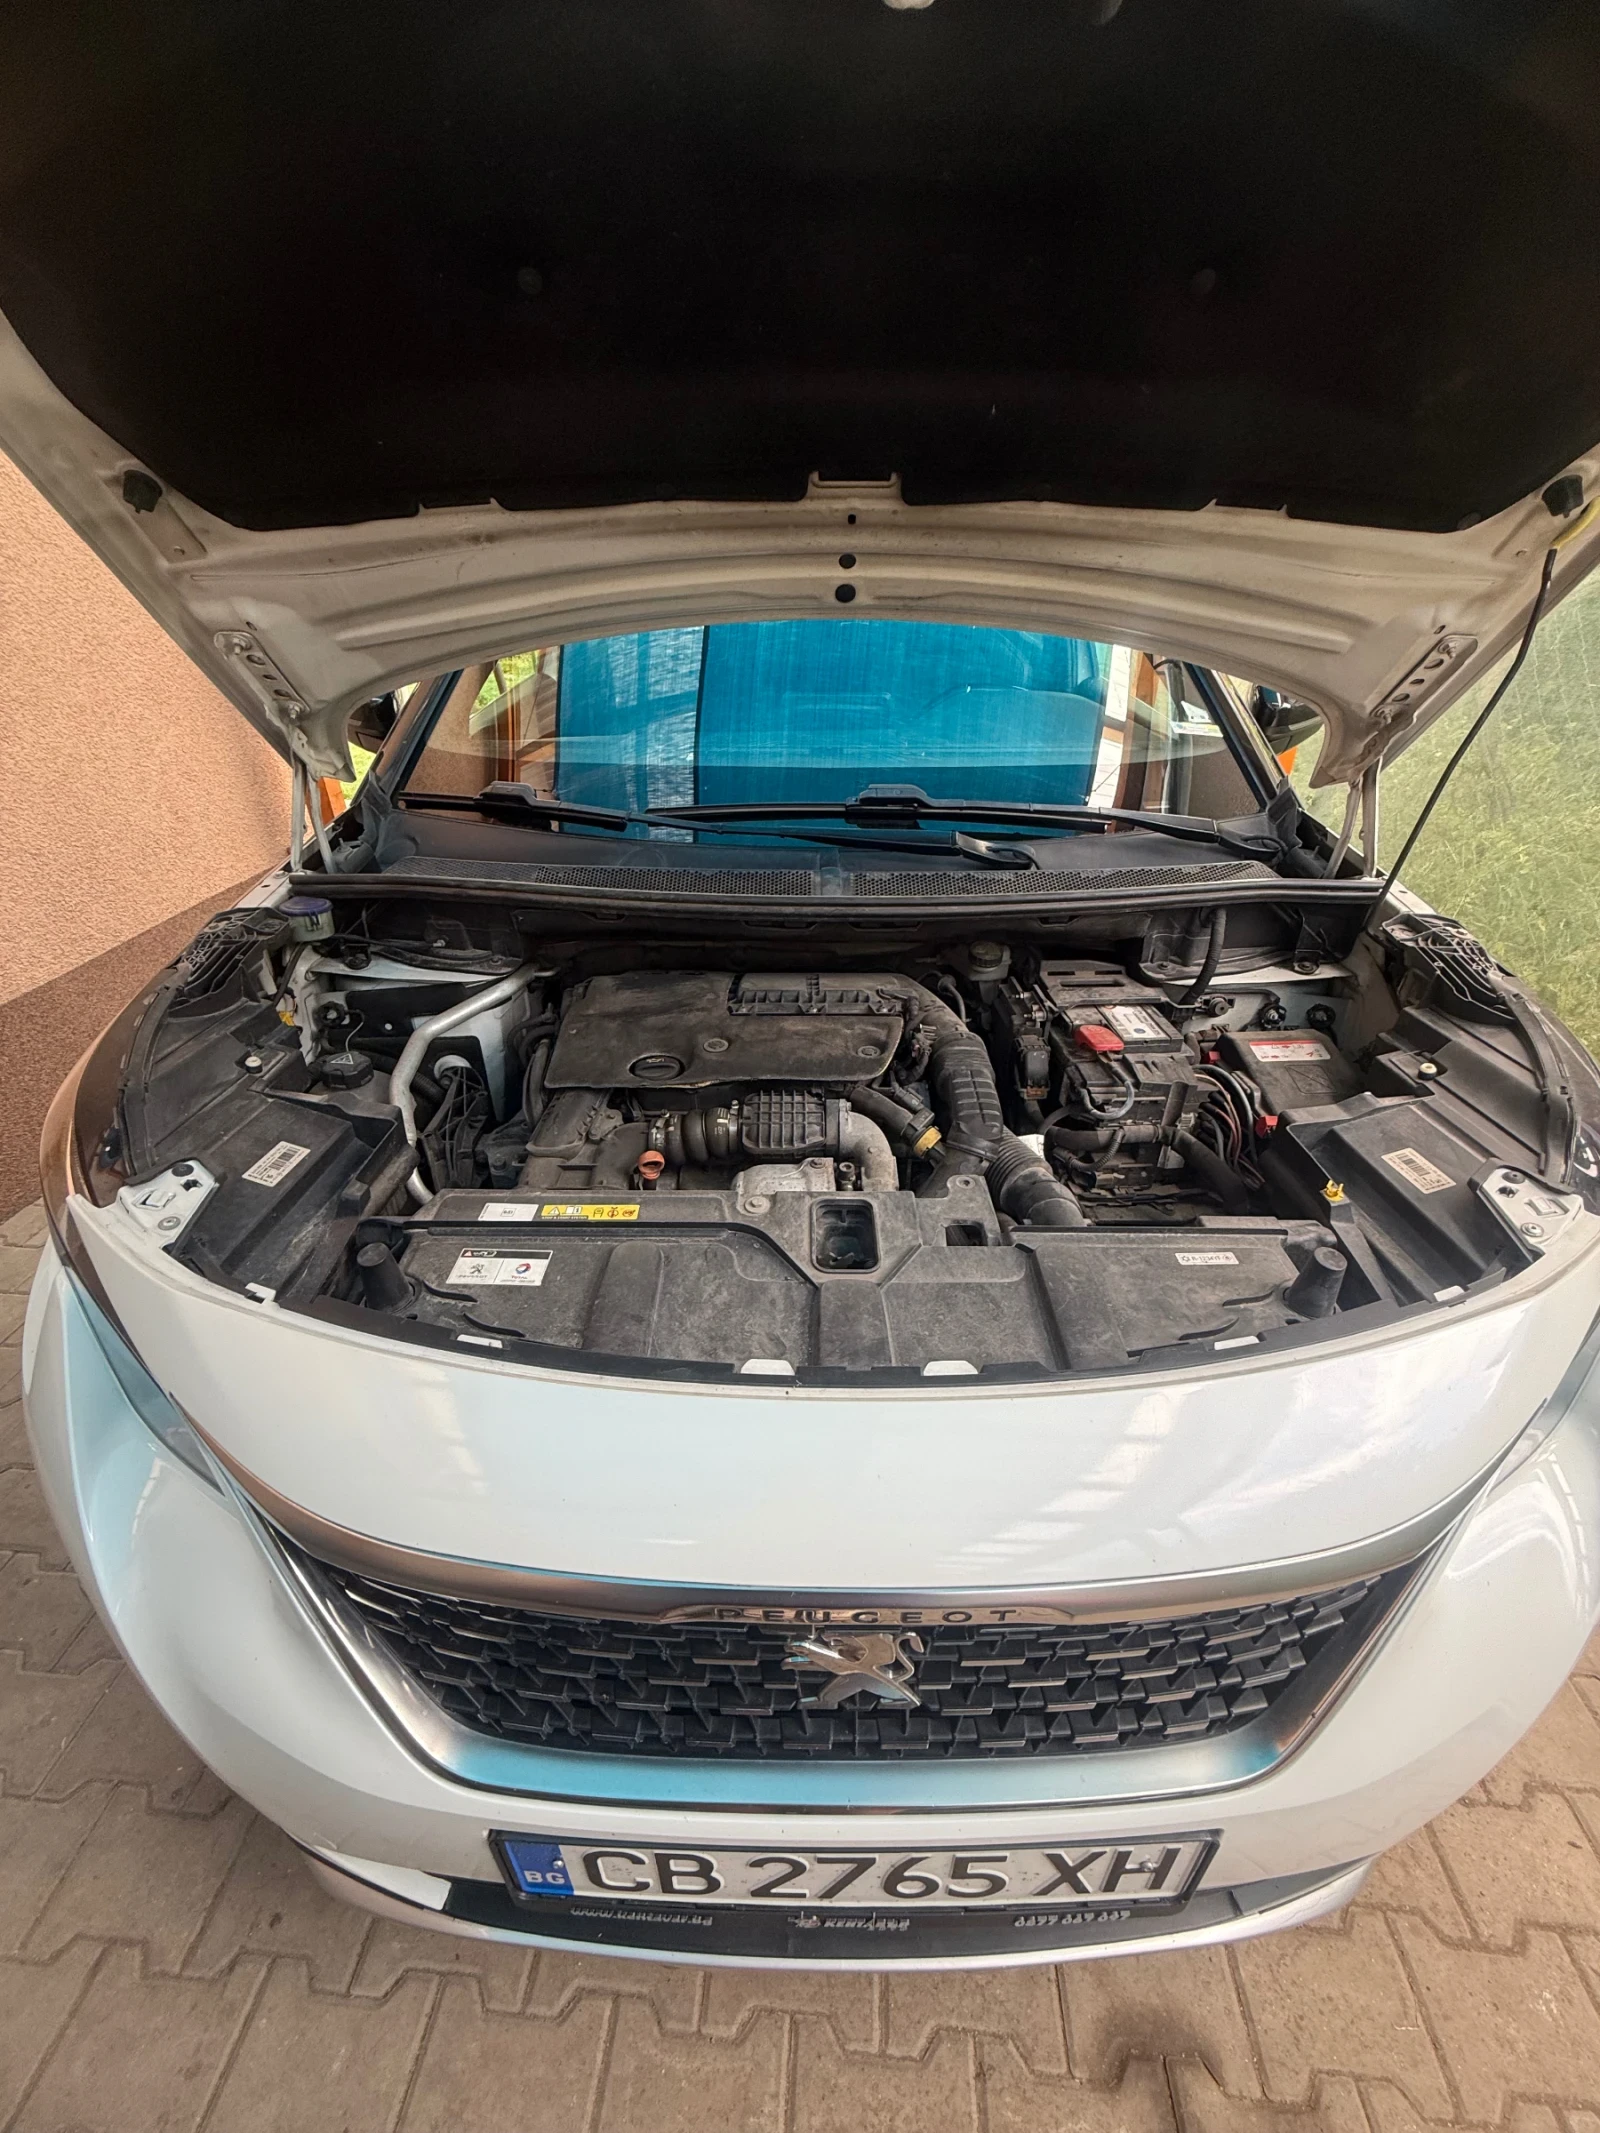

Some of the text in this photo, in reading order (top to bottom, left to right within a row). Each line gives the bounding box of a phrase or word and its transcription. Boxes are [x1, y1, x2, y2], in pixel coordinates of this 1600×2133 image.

[713, 1608, 1017, 1625] PEUGEOT
[524, 1870, 565, 1885] BG
[583, 1847, 1183, 1898] CB 2765 XH
